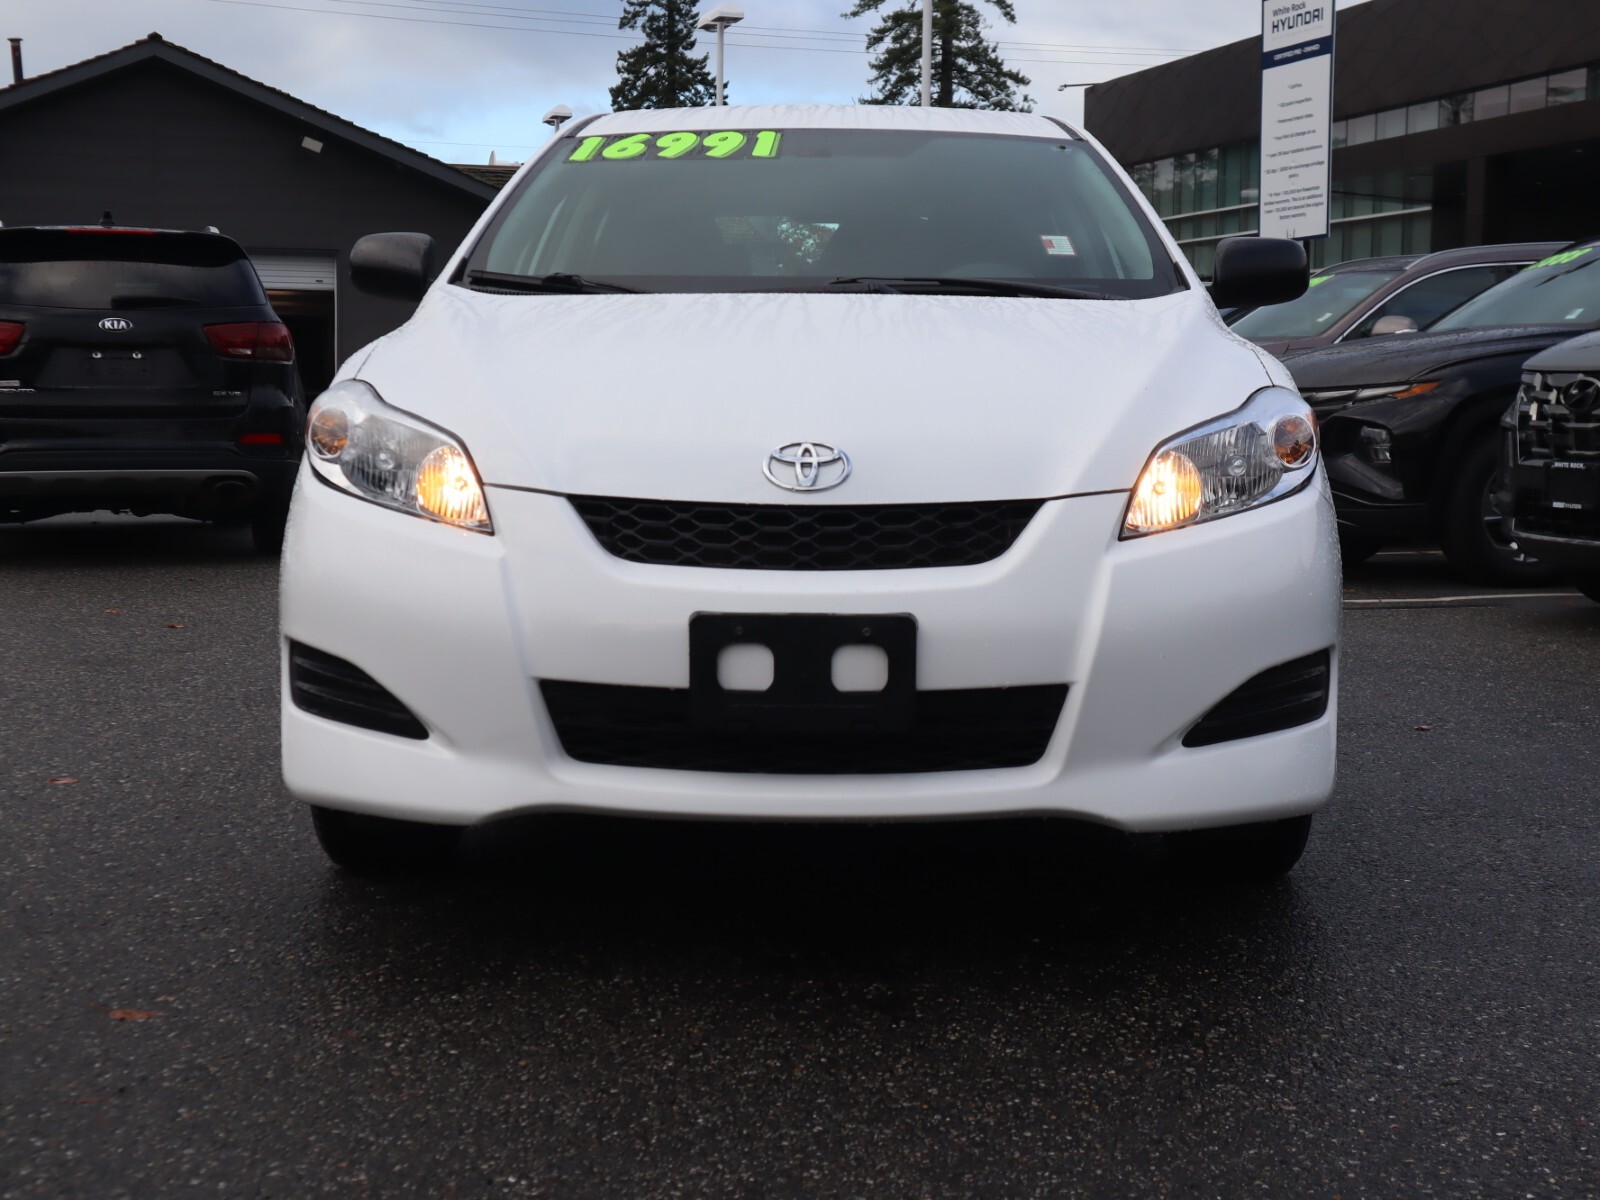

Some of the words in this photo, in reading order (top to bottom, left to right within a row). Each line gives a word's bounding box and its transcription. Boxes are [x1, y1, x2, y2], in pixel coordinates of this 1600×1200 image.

[1272, 6, 1290, 17] White
[1291, 2, 1306, 12] Rock
[1272, 7, 1324, 34] HYUNDAI
[568, 131, 782, 162] 16991
[104, 320, 128, 330] KIA
